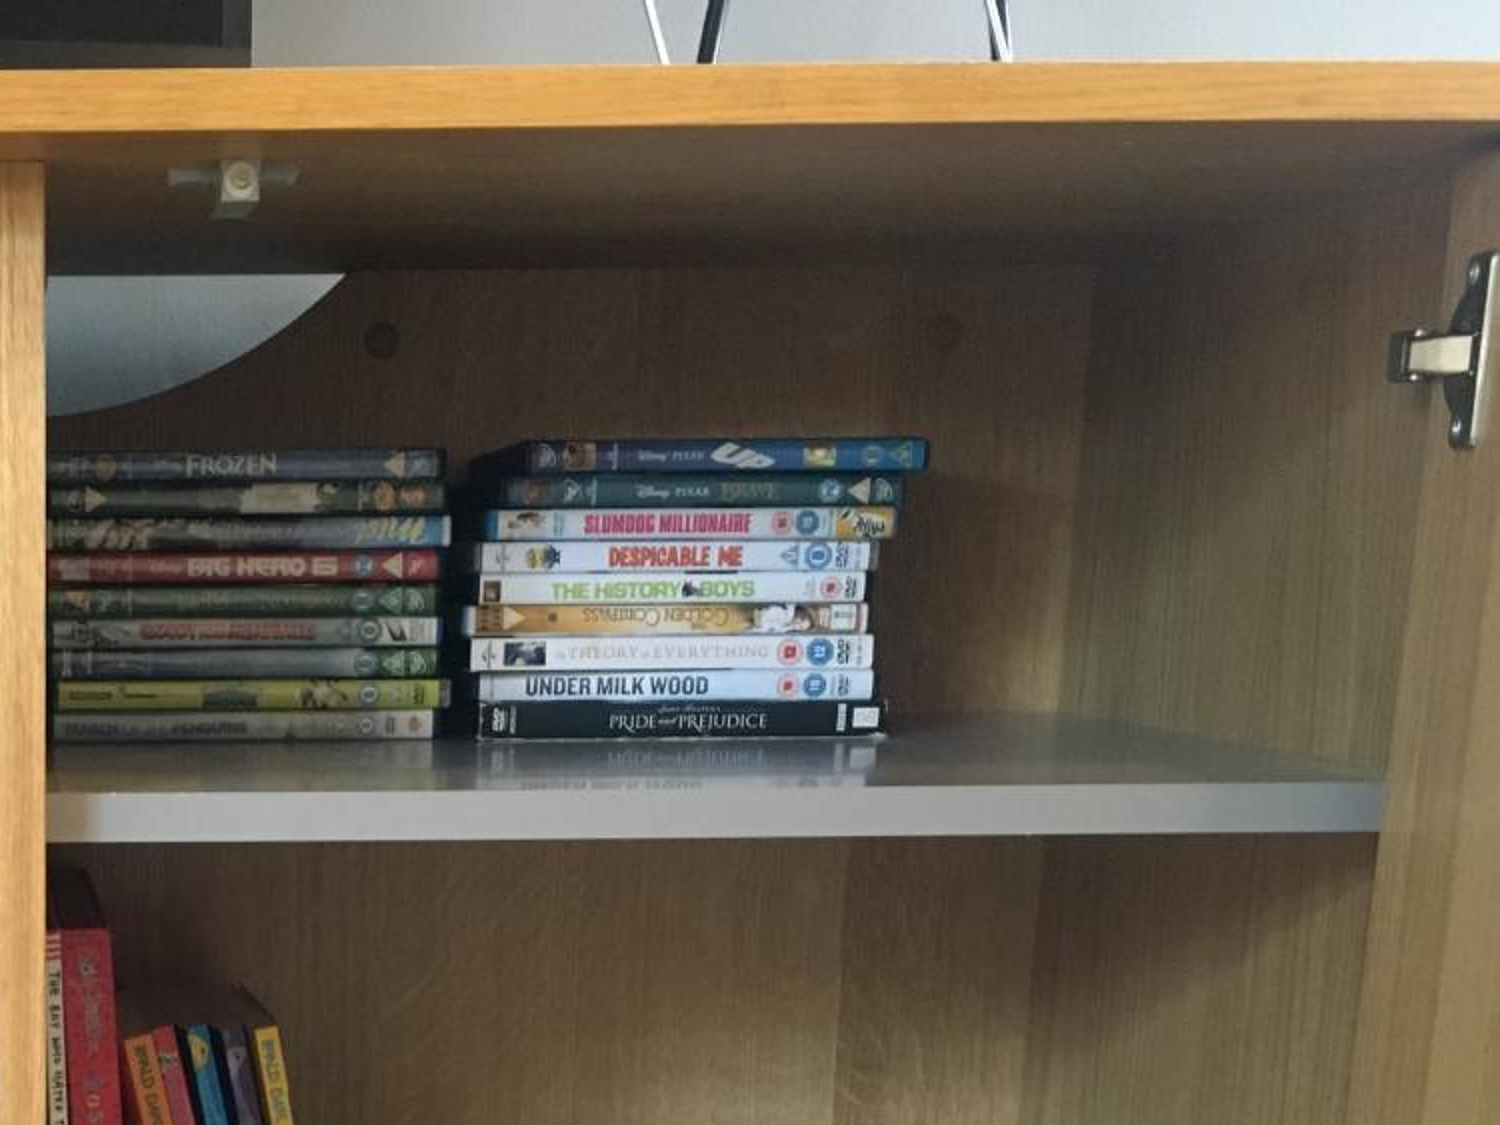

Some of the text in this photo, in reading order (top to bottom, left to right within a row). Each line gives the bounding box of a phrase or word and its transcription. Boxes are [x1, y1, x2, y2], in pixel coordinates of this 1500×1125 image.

[186, 453, 277, 478] FROZEN
[584, 513, 752, 534] SLUMDOG MILLIONAIRE
[188, 557, 231, 577] BIG
[237, 557, 307, 577] HERO
[609, 546, 743, 567] DESPICABLE ME
[552, 582, 590, 600] THE
[699, 580, 756, 598] BOYS
[569, 646, 639, 659] THEORY
[653, 646, 769, 659] EVERYTHING
[526, 675, 709, 696] UNDER MILK WOOD
[609, 713, 657, 733] PRIDE
[678, 712, 769, 733] PREJUDICE
